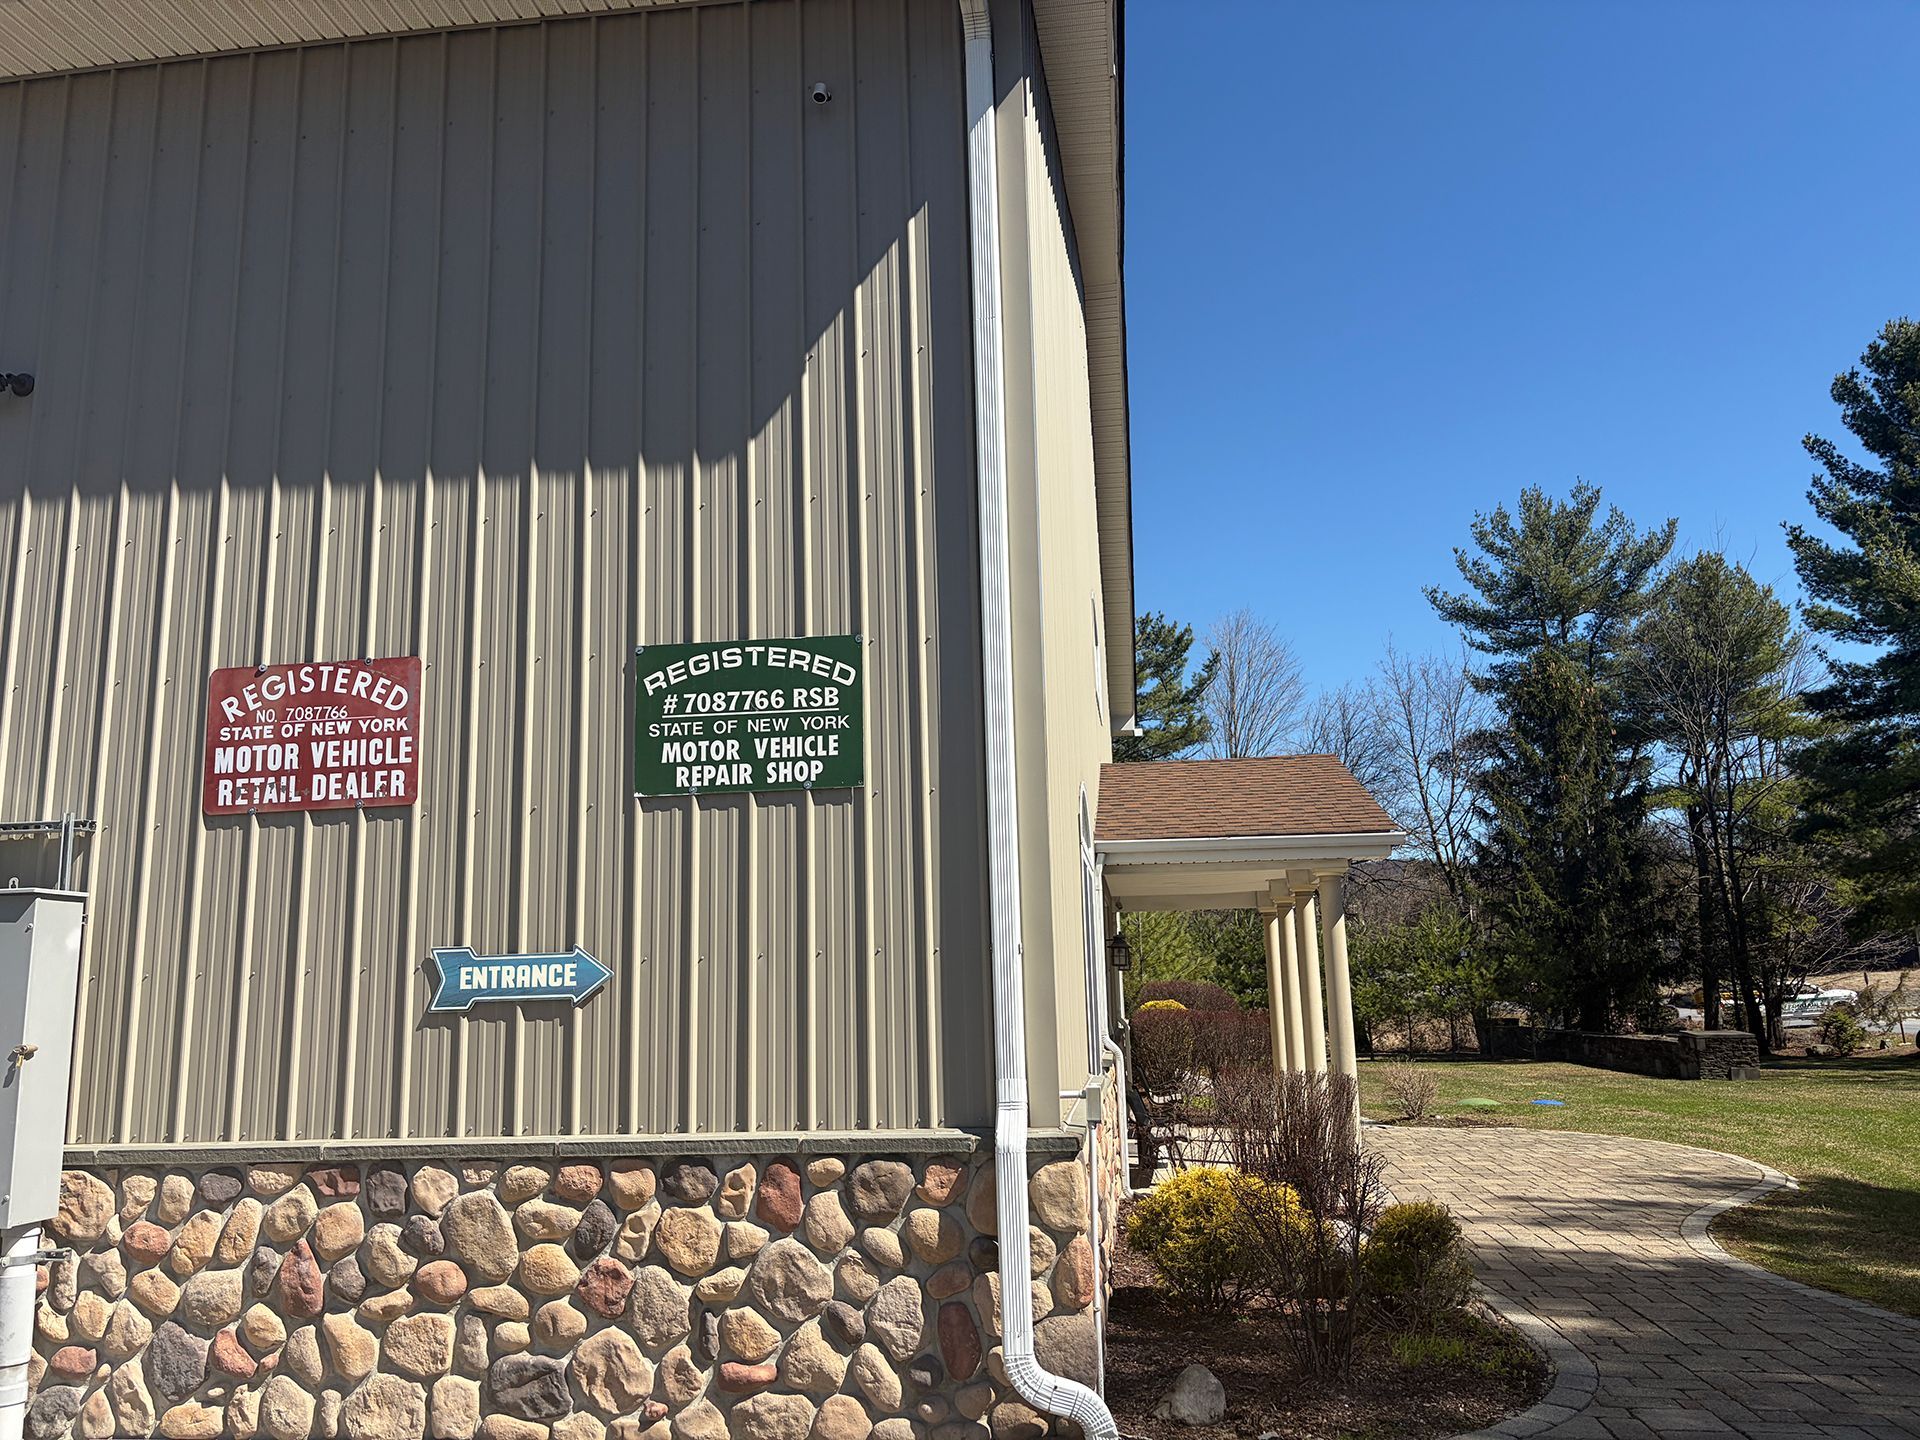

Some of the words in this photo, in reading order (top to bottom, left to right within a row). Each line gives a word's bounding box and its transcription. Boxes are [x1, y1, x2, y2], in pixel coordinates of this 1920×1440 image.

[643, 646, 857, 696] REGISTERED
[220, 665, 409, 723] REGISTERED
[663, 694, 678, 714] #
[683, 689, 785, 713] 7087766
[793, 686, 840, 708] RSB
[256, 708, 278, 723] NO.
[286, 705, 348, 721] 7087766
[648, 722, 703, 737] STATE
[713, 720, 738, 734] OF
[747, 717, 789, 733] NEW
[800, 715, 850, 730] YORK
[219, 725, 274, 742] STATE
[281, 723, 305, 738] OF
[311, 721, 351, 736] NEW
[359, 717, 408, 733] YORK
[214, 743, 299, 774] MOTOR
[310, 736, 413, 769] VEHICLE
[661, 739, 740, 763] MOTOR
[754, 734, 839, 759] VEHICLE
[676, 763, 753, 787] REPAIR
[766, 760, 824, 783] SHOP
[217, 776, 302, 806] RETAIL
[311, 770, 405, 802] DEALER
[459, 963, 577, 990] ENTRANCE
